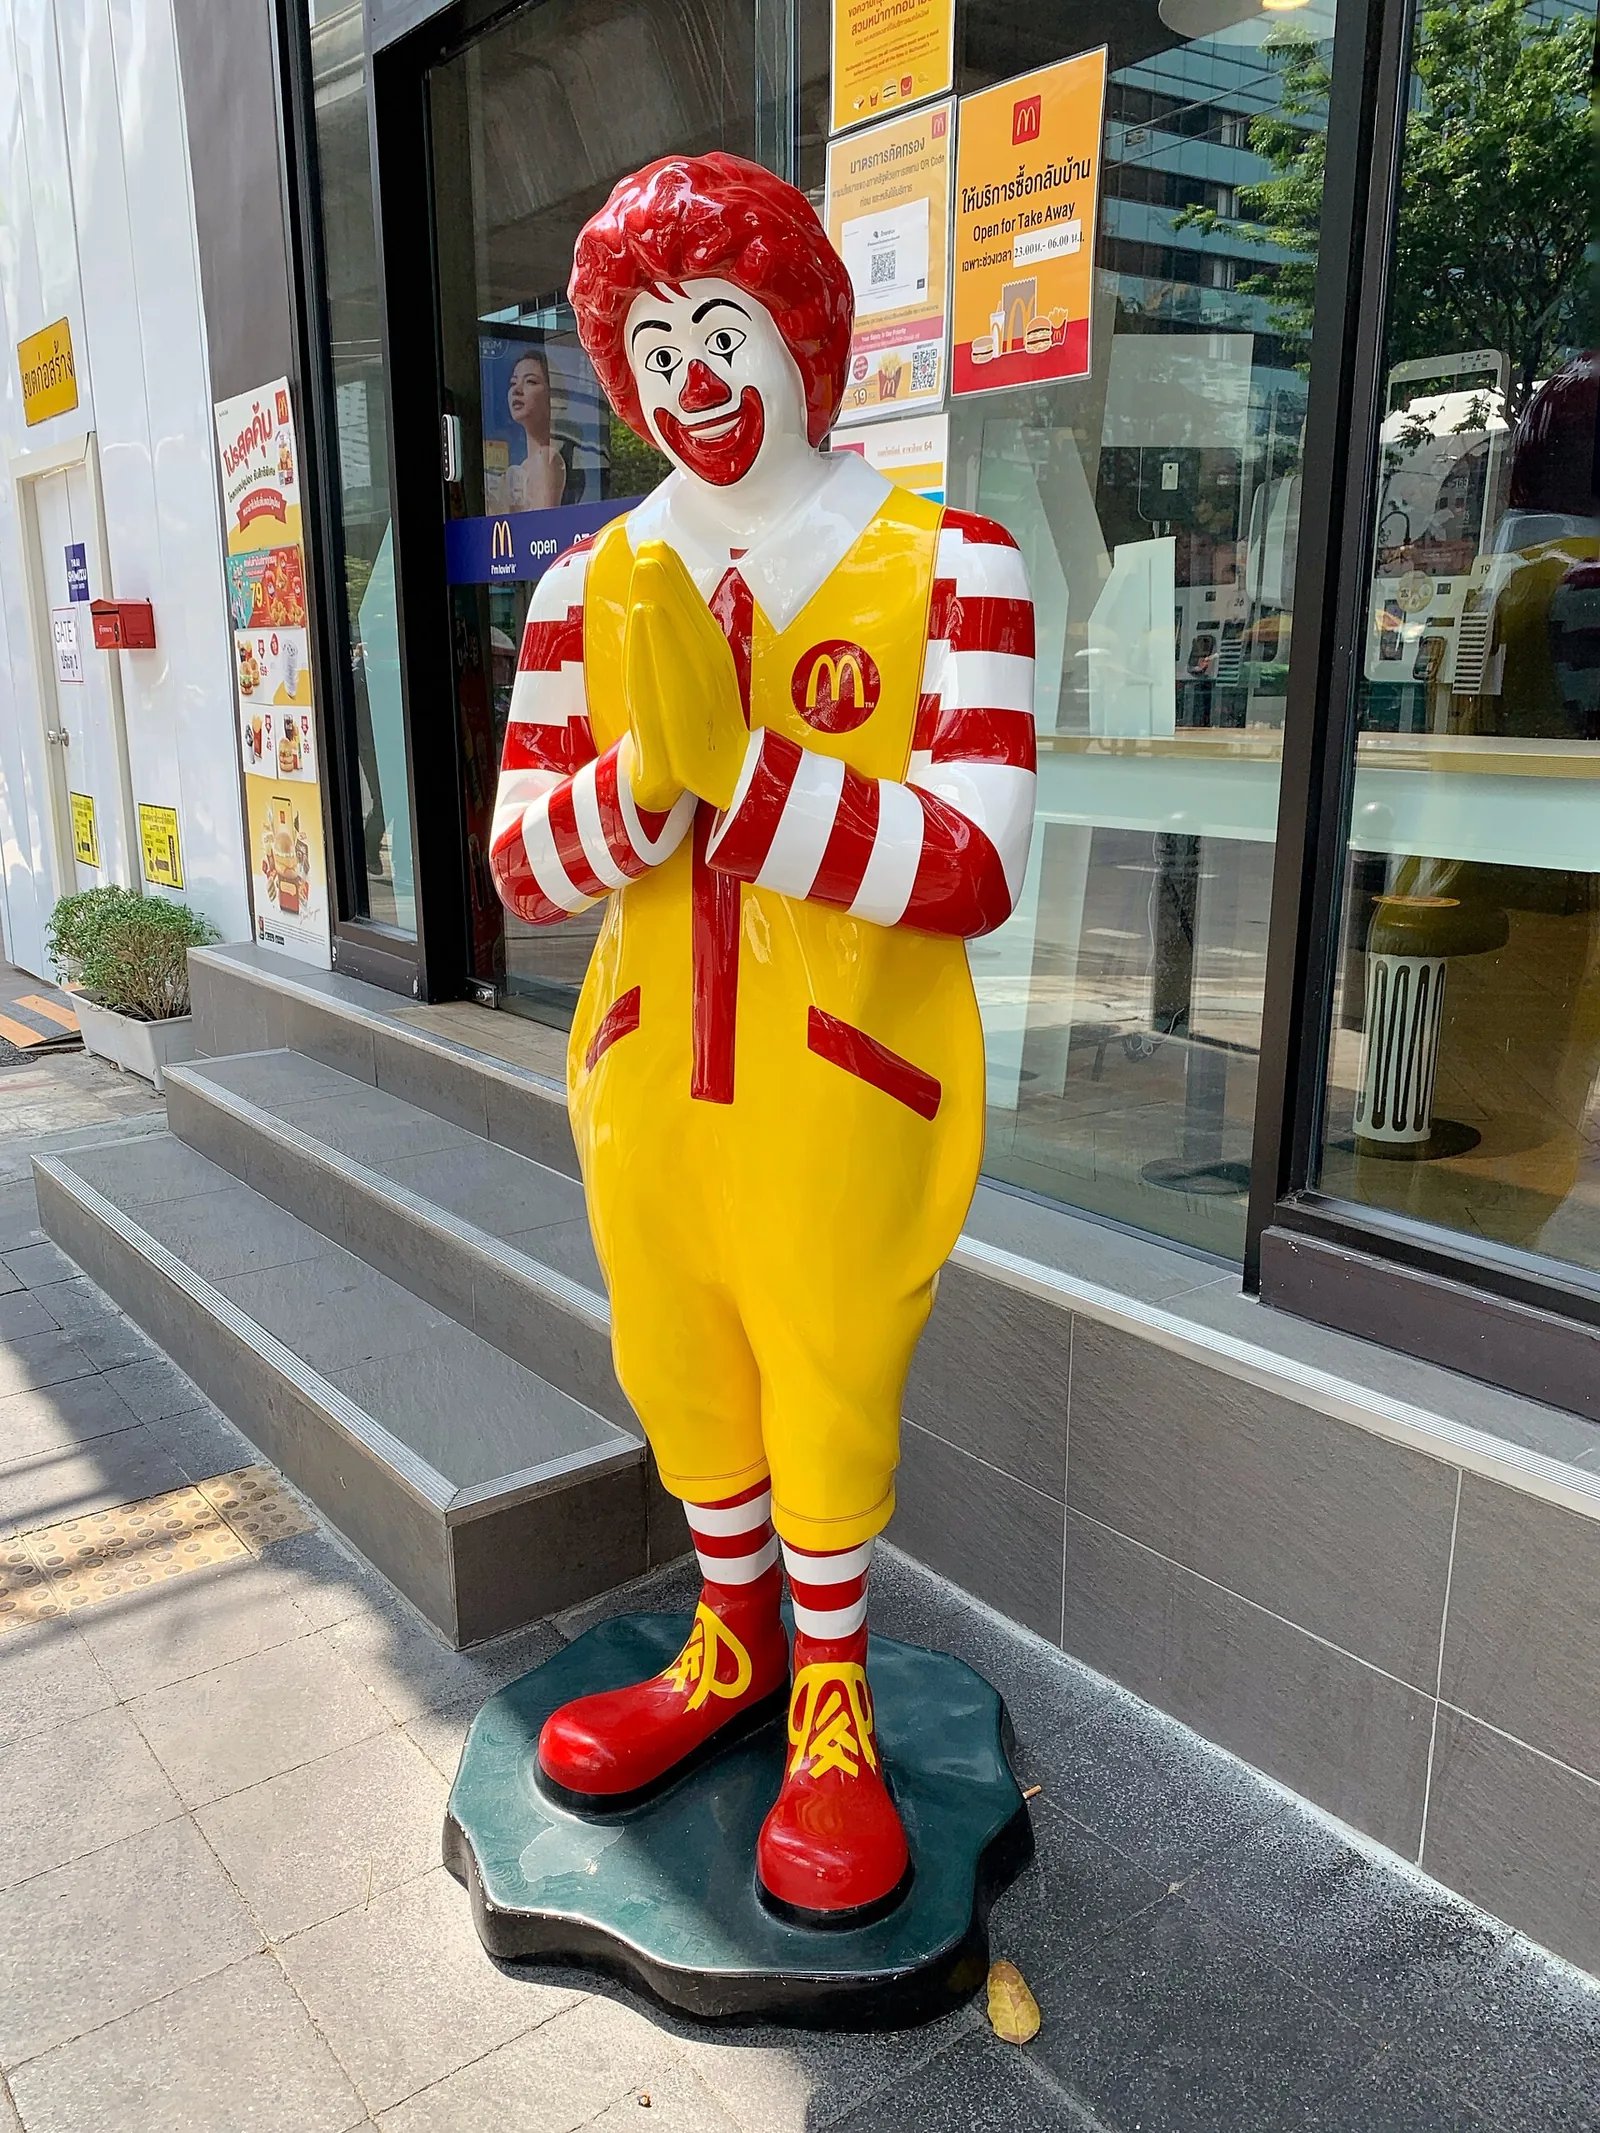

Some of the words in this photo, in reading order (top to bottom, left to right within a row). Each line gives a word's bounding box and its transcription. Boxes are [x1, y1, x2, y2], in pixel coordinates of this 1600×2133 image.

[850, 137, 925, 174] มาตรการคัดกรอง
[962, 156, 1091, 214] ให้บริการซื้อกลับบ้าน
[973, 221, 999, 244] Open
[1001, 218, 1016, 235] for
[1018, 210, 1043, 229] Take
[1045, 202, 1076, 222] Away
[962, 249, 1013, 273] เฉพาะช่วงเวลา
[22, 340, 74, 399] เขตก่อสร้าง
[853, 388, 867, 405] 19
[530, 538, 557, 560] open
[250, 581, 263, 608] 79
[53, 620, 73, 643] GATE
